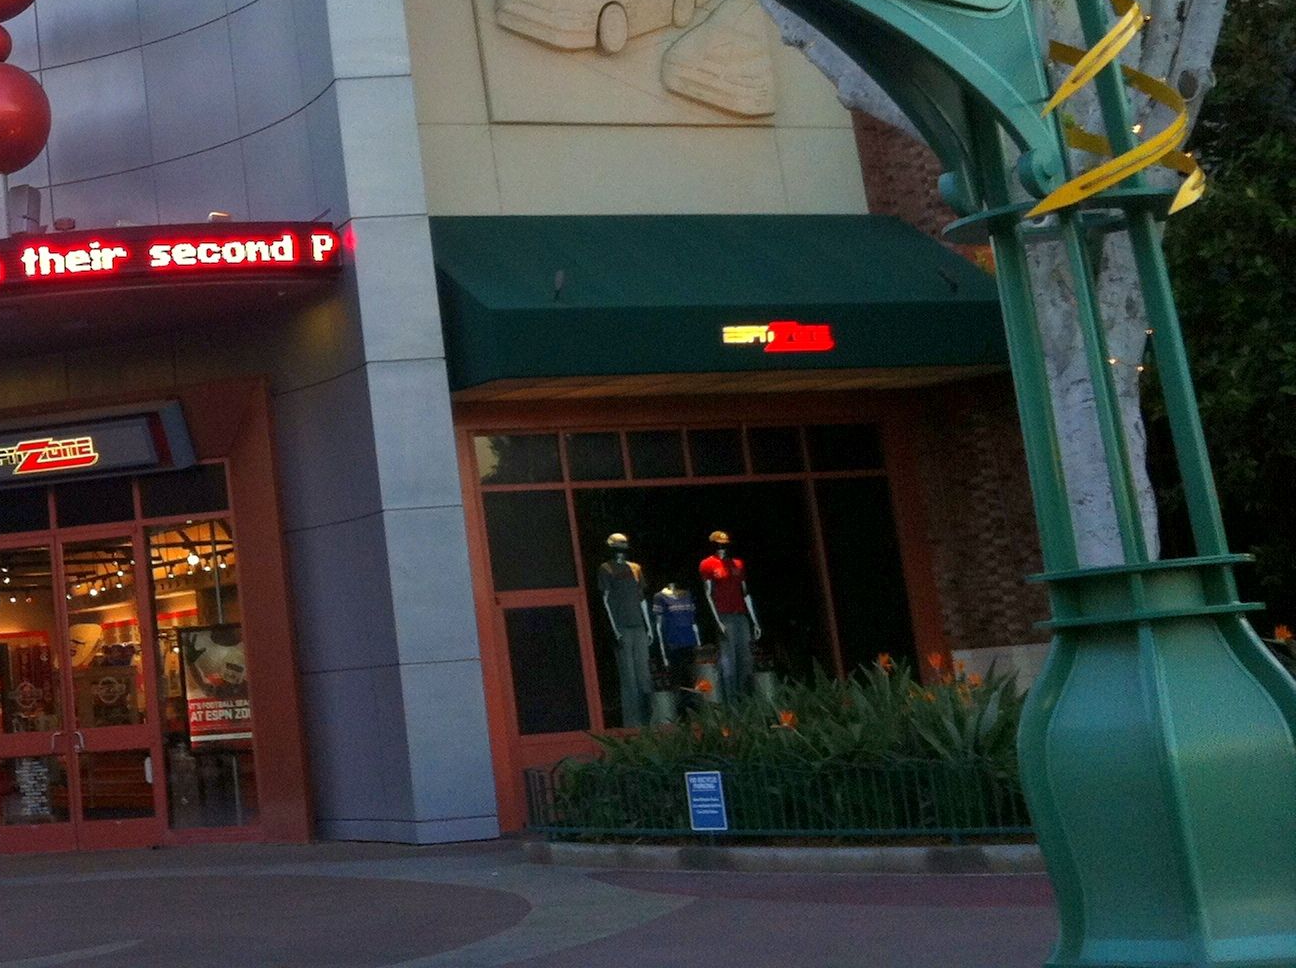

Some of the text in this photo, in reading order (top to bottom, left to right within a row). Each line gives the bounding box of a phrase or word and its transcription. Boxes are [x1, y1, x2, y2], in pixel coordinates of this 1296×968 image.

[21, 240, 128, 277] their
[148, 234, 294, 268] second
[310, 234, 334, 262] P
[190, 711, 203, 722] AT
[205, 709, 233, 721] ESPN
